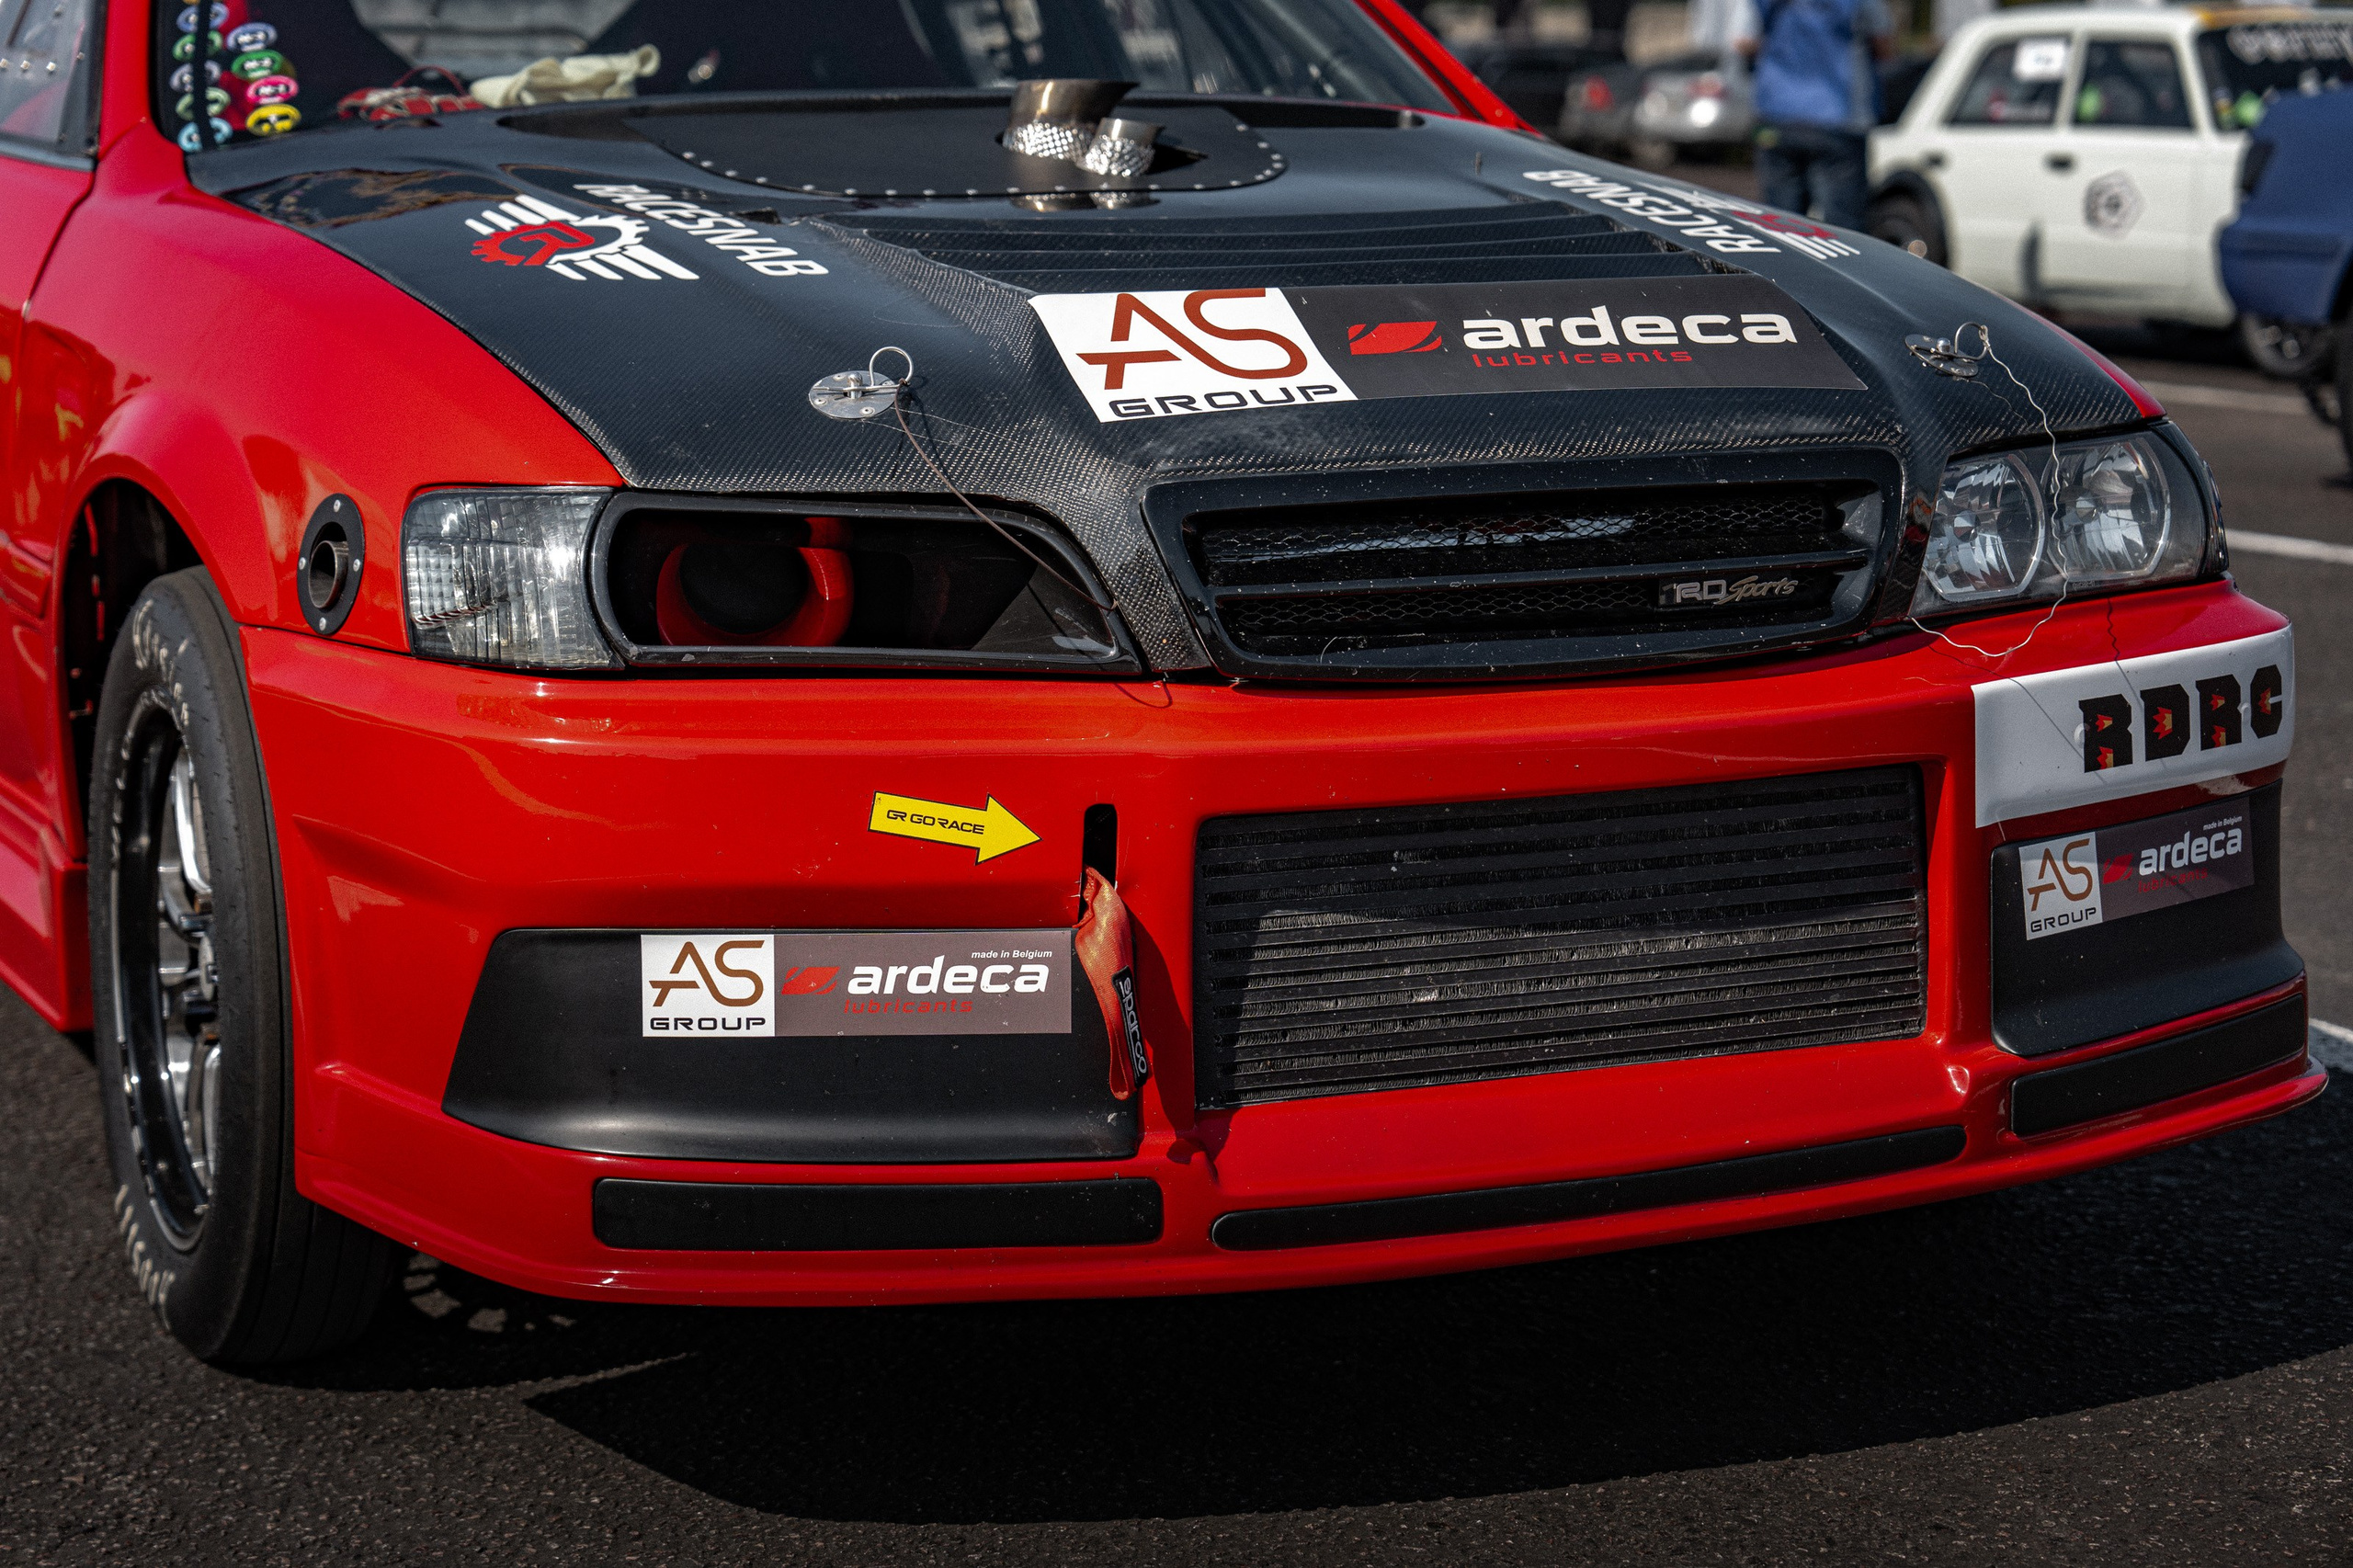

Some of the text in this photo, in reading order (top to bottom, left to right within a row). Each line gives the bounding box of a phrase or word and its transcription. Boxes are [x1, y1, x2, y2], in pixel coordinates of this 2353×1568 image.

[1523, 169, 1782, 253] RACESNAB
[573, 184, 829, 276] RACESNAB
[1075, 288, 1308, 391] AS
[1463, 305, 1798, 350] ardeca
[1472, 349, 1693, 368] lubricants
[1108, 384, 1338, 418] GROUP
[1712, 575, 1799, 606] Sports
[2078, 664, 2283, 774] RDRC
[886, 809, 985, 835] GR GO RACE
[2203, 822, 2217, 831] made
[2223, 815, 2243, 826] Belgium
[2138, 827, 2243, 877] ardeca
[2027, 837, 2094, 912] AS
[2138, 867, 2209, 893] lubricants
[2030, 906, 2097, 933] GROUP
[971, 949, 1052, 960] made in Belgium
[649, 940, 766, 1007] AS
[847, 955, 1051, 995] ardeca
[649, 1017, 767, 1031] GROUP
[844, 998, 974, 1015] lubricants
[1120, 977, 1148, 1075] sparco
